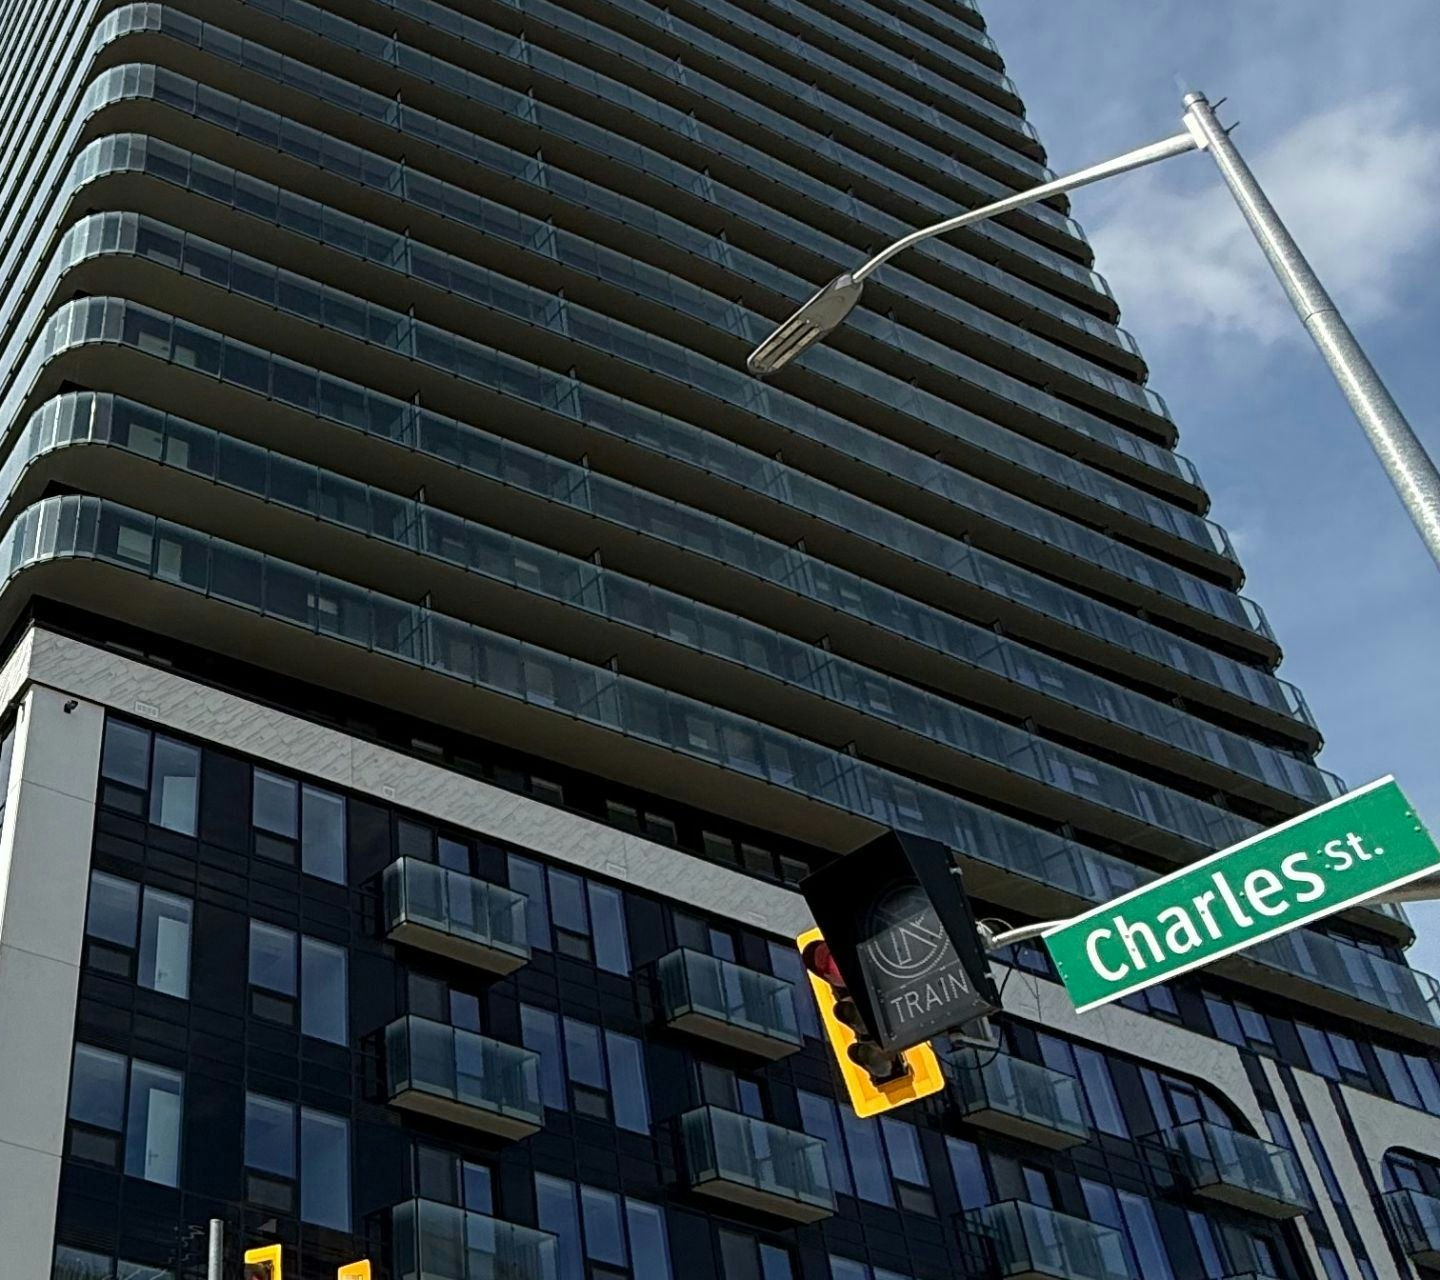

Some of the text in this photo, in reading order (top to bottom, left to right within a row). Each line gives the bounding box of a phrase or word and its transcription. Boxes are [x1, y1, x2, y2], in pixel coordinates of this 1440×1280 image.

[1086, 832, 1384, 981] Charles St.
[890, 969, 969, 1023] TRAIN
